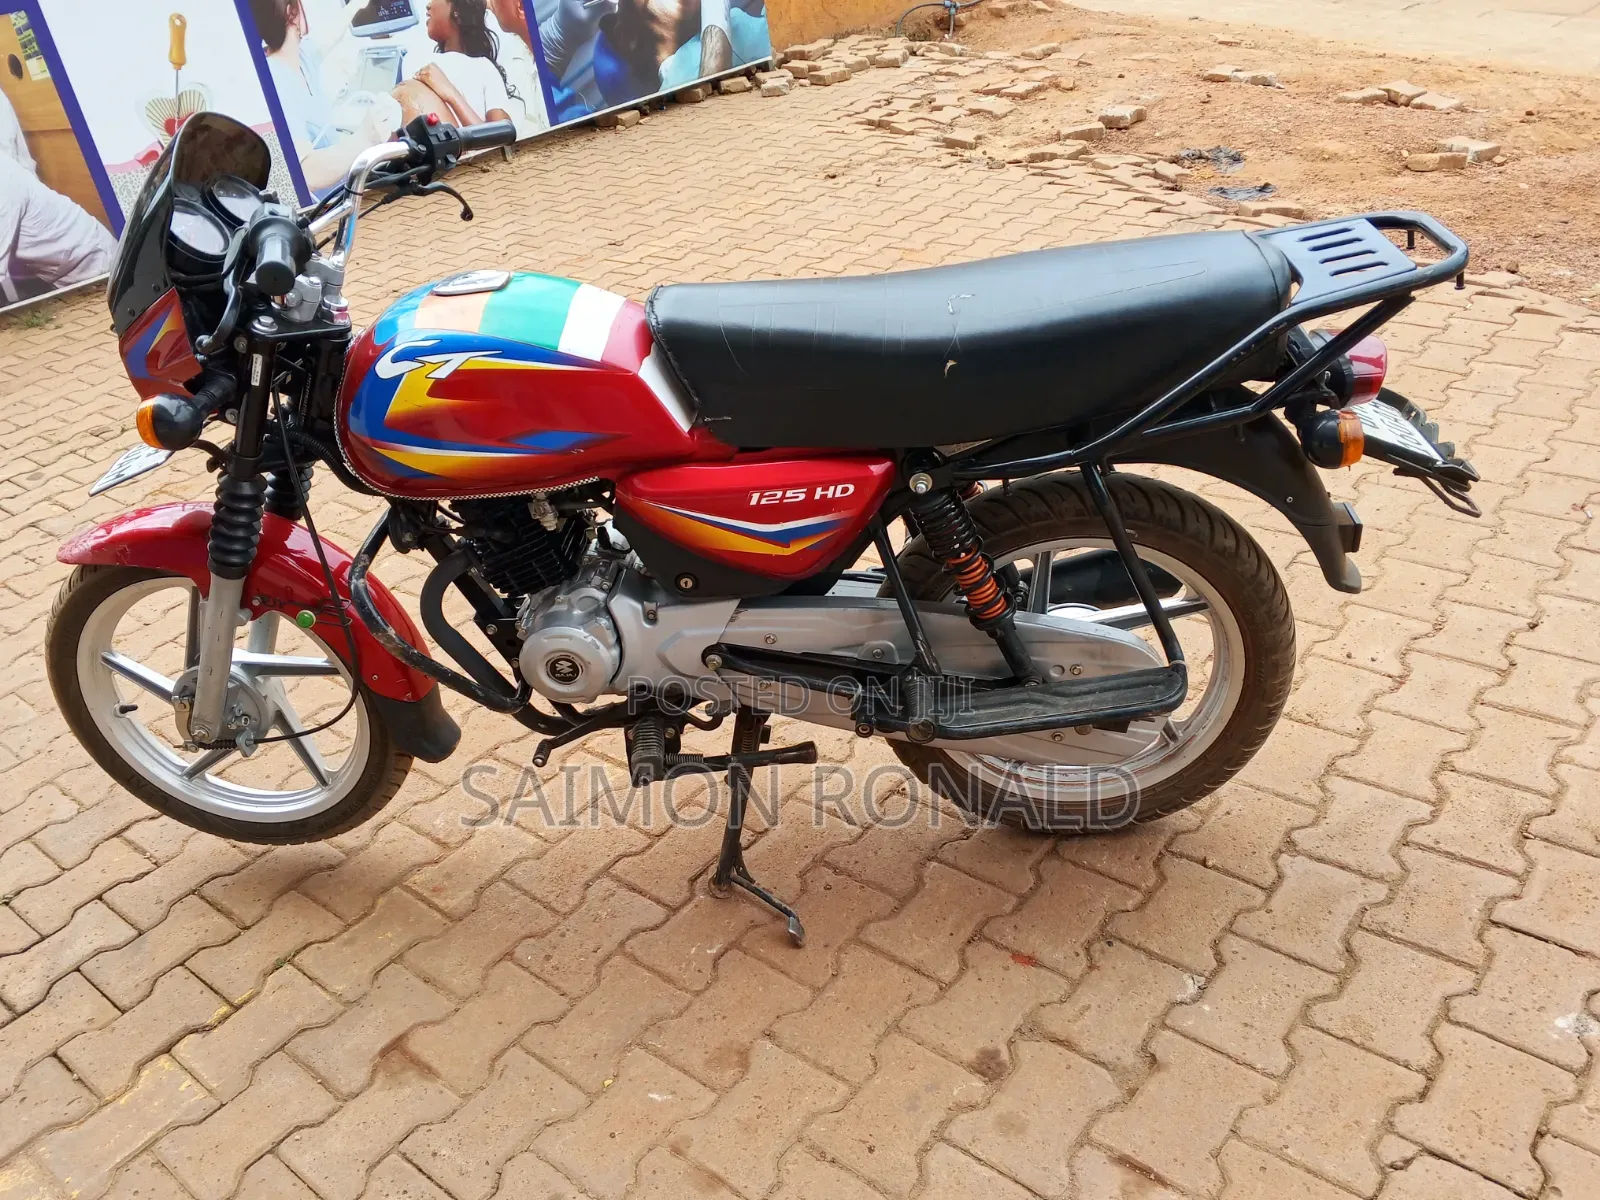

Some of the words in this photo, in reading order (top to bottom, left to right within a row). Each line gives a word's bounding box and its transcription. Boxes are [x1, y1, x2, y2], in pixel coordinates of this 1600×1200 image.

[374, 339, 503, 380] CT
[749, 488, 807, 506] 125
[814, 483, 855, 501] HD
